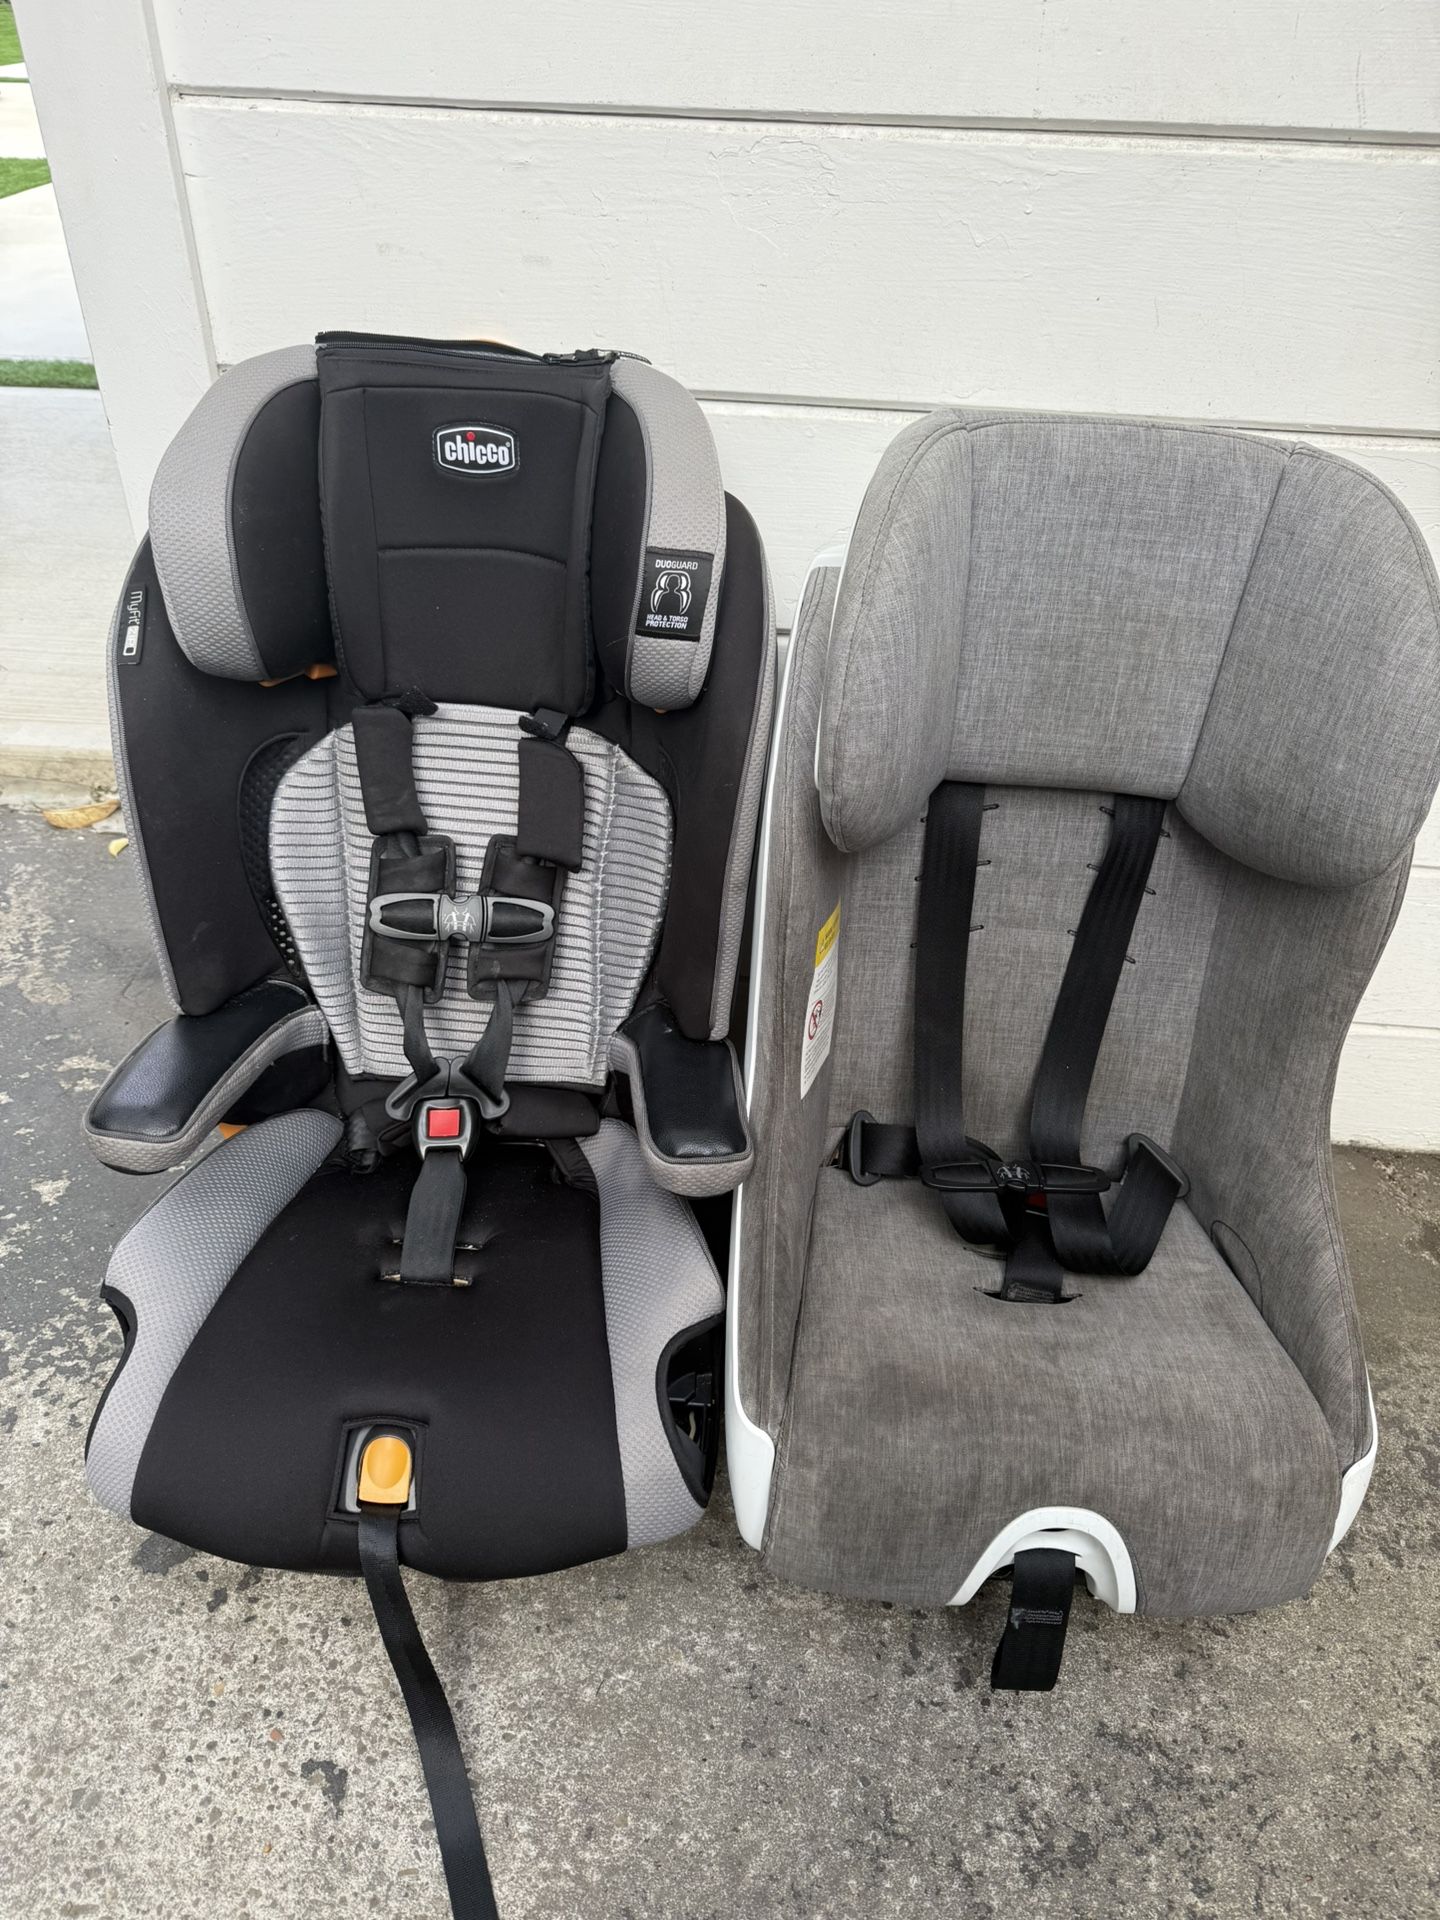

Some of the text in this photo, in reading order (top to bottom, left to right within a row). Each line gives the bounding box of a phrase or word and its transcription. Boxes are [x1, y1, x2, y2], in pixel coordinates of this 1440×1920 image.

[444, 431, 509, 466] chicco
[655, 559, 698, 570] DUOGUARD
[646, 613, 662, 621] HEAD
[669, 615, 689, 623] TORSO
[645, 620, 688, 630] PROTECTION
